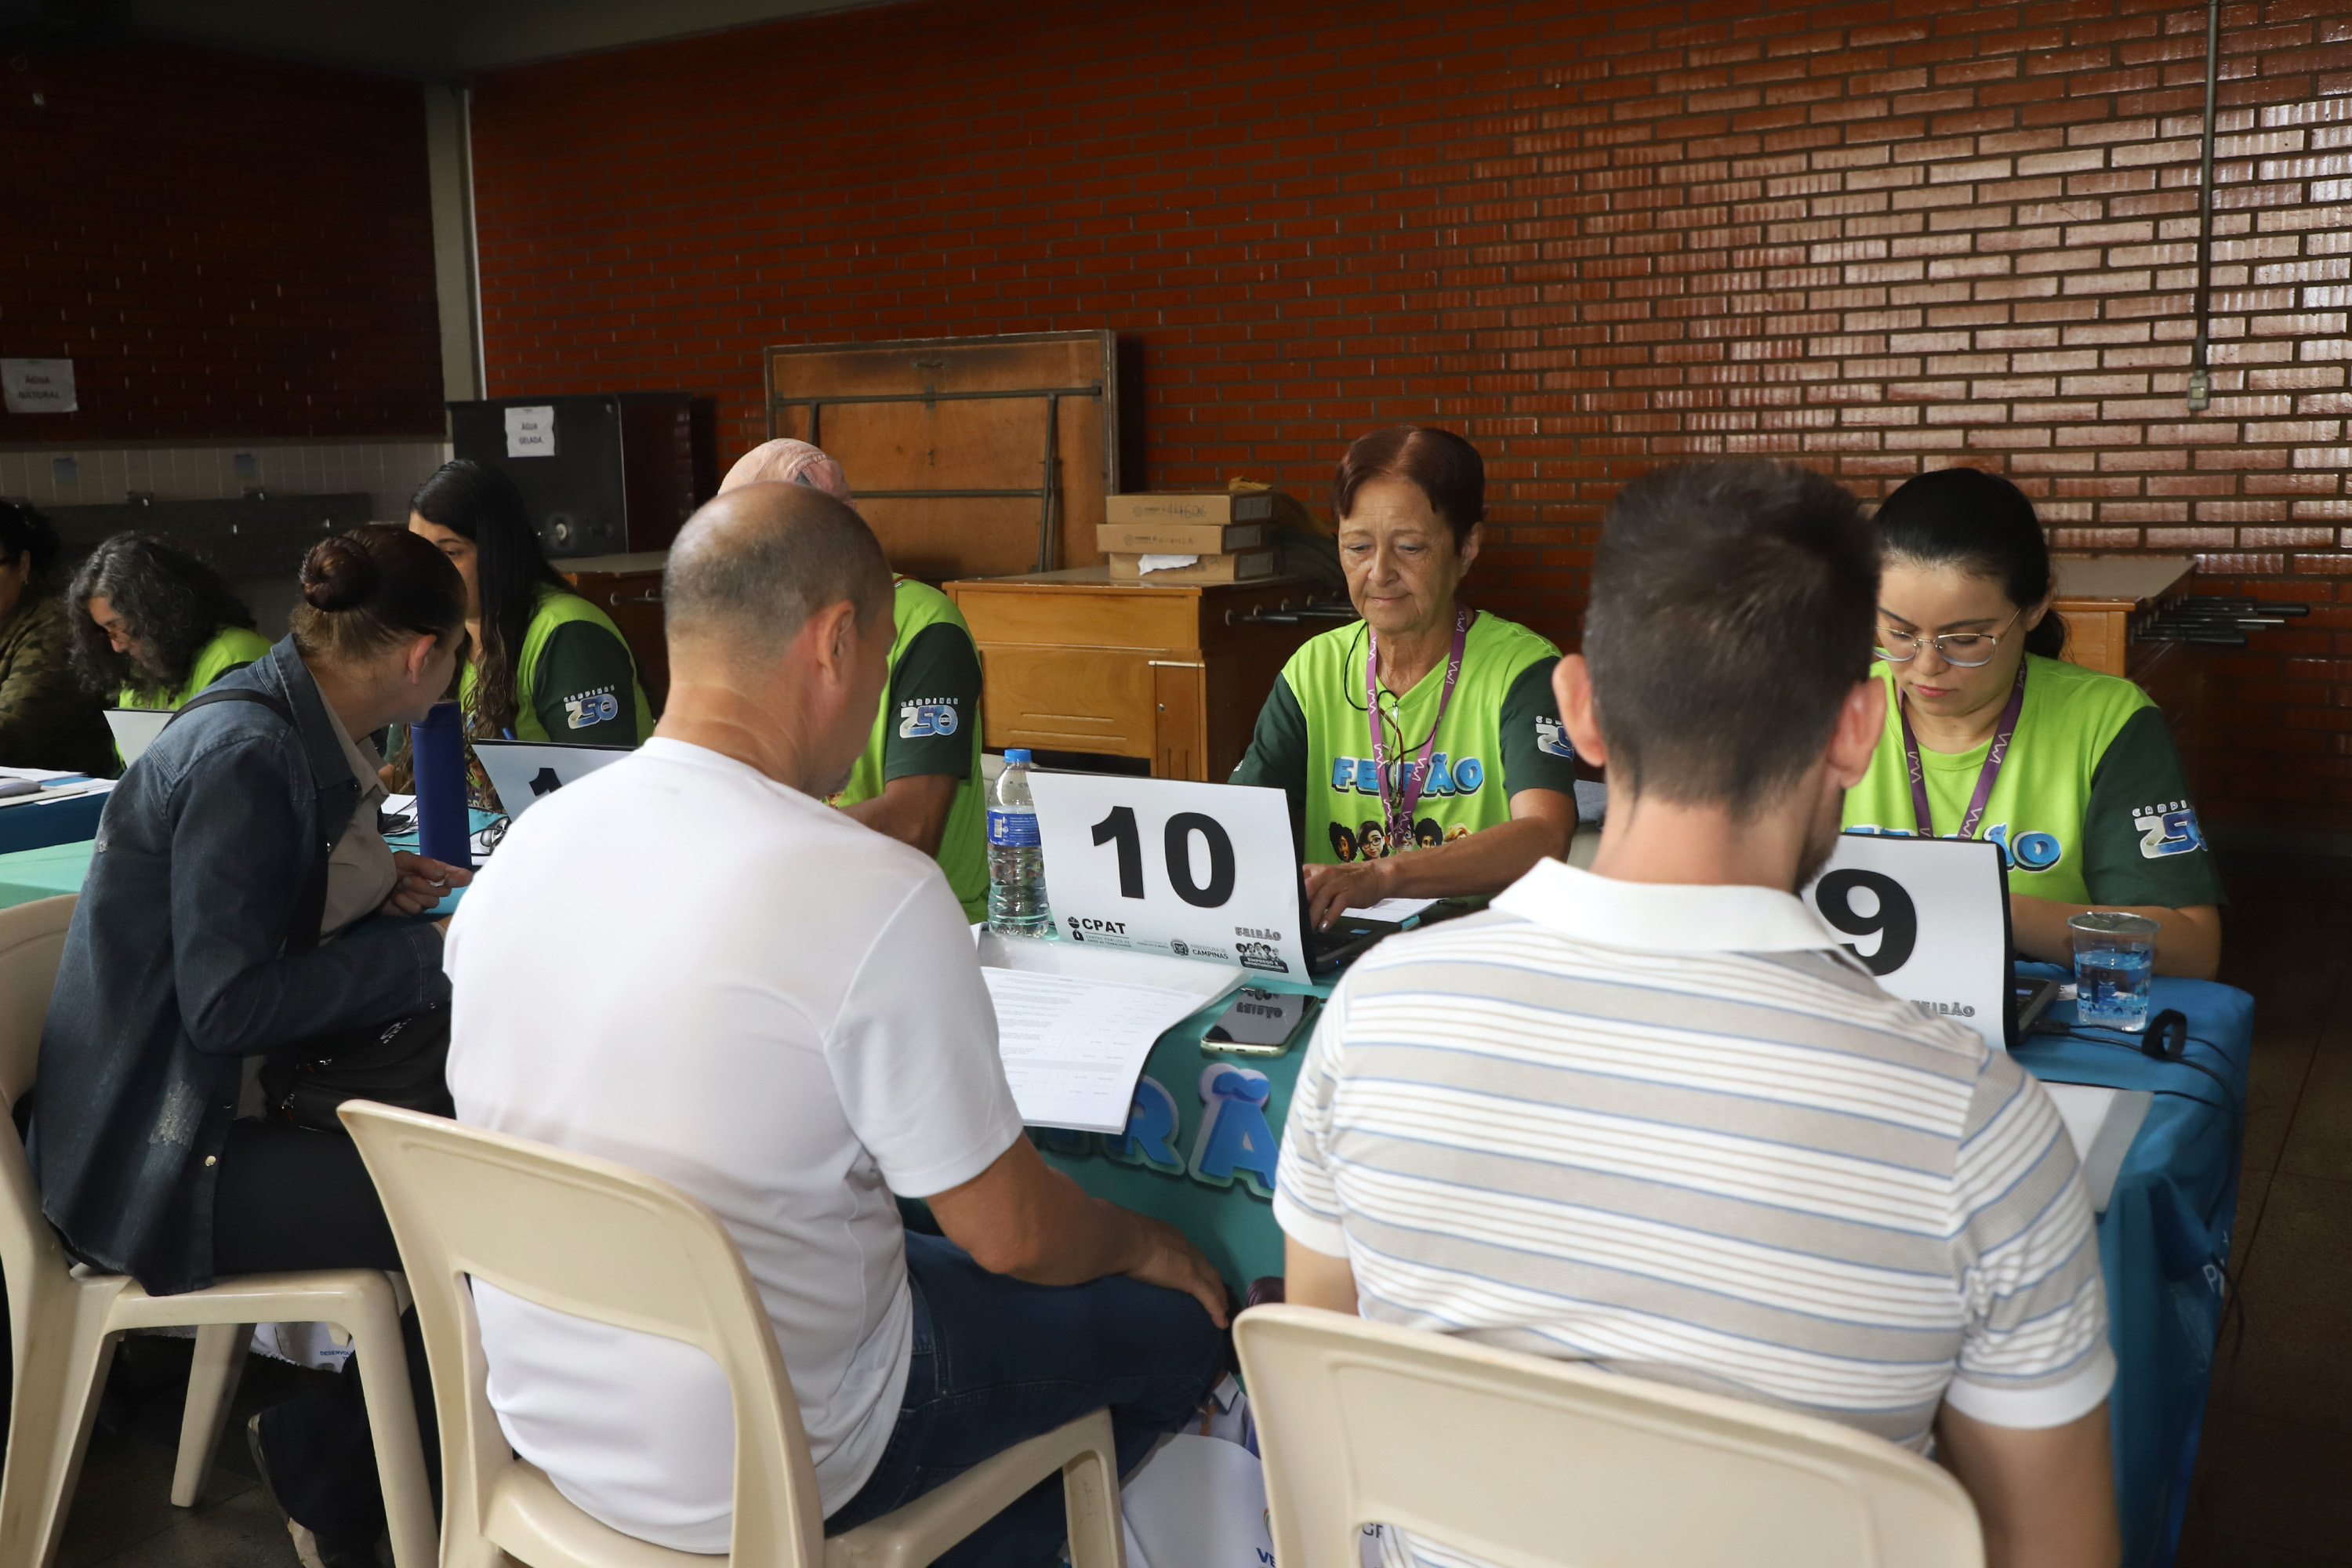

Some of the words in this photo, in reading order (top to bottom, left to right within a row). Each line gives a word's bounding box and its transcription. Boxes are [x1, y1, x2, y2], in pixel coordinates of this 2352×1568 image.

[564, 693, 618, 729] 250
[901, 697, 958, 707] CAMPINAS
[899, 704, 958, 739] 250
[1091, 806, 1236, 908] 10
[1082, 918, 1126, 935] CPAT
[1235, 927, 1281, 941] FEIRÃO
[1815, 869, 1917, 976] 9
[1192, 949, 1229, 959] CAMPINAS
